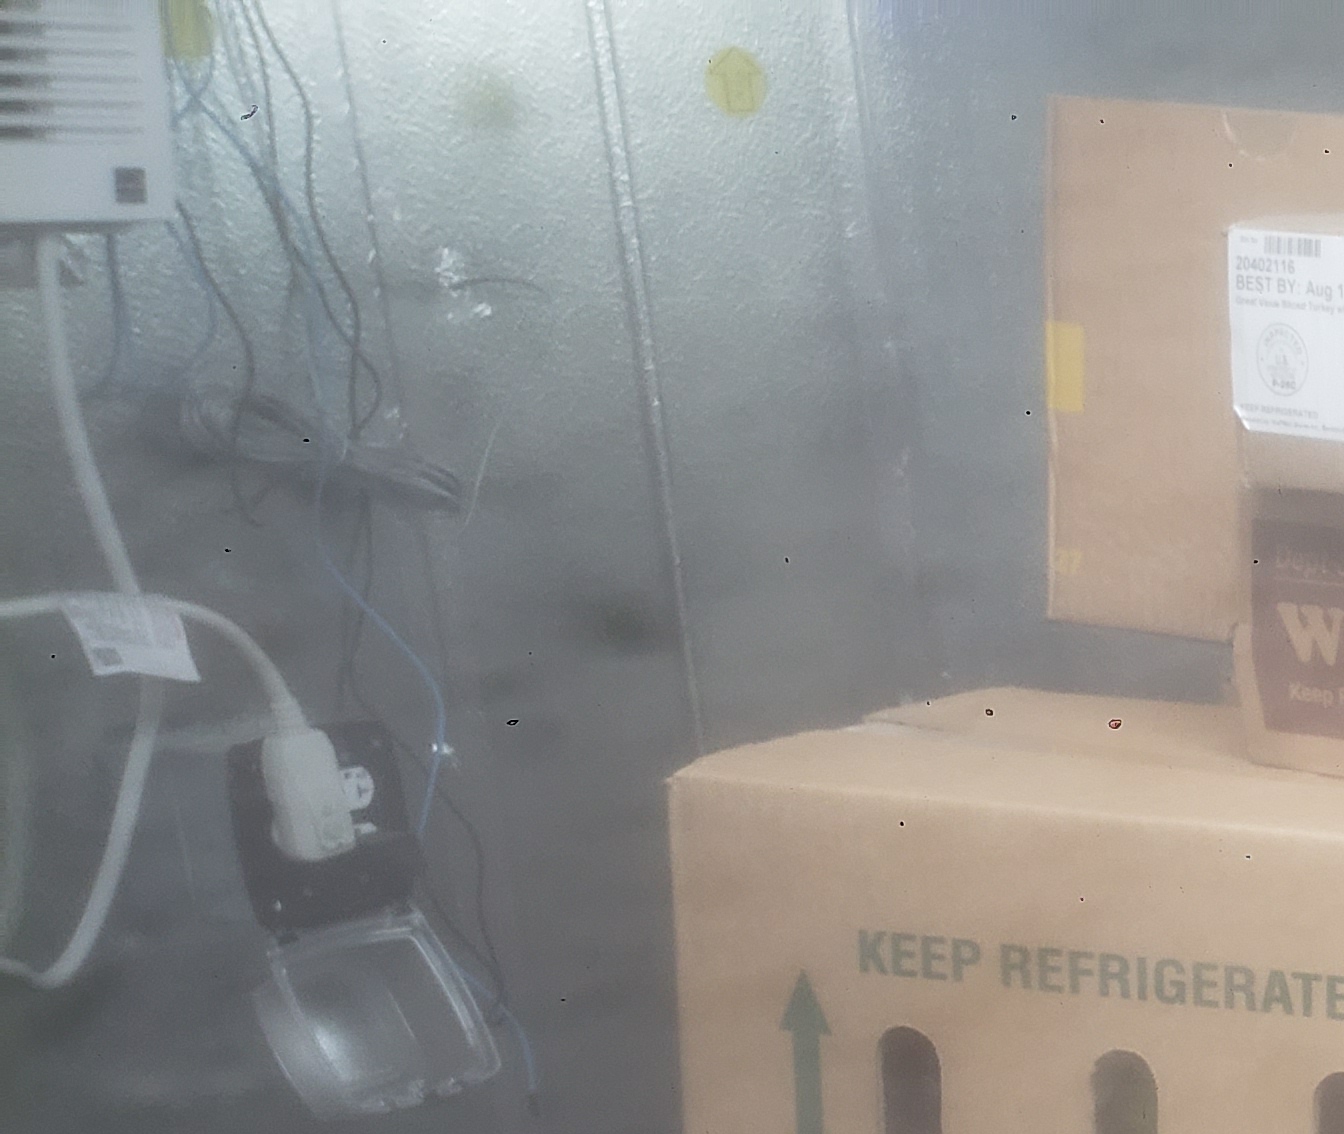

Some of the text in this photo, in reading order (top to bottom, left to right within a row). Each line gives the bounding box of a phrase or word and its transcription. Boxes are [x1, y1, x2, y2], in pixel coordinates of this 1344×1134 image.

[1234, 255, 1294, 274] 20402116
[1235, 273, 1271, 294] BEST
[1276, 278, 1301, 295] BY:
[1305, 281, 1332, 300] Aug
[1289, 682, 1334, 708] Keep
[857, 929, 981, 983] KEEP
